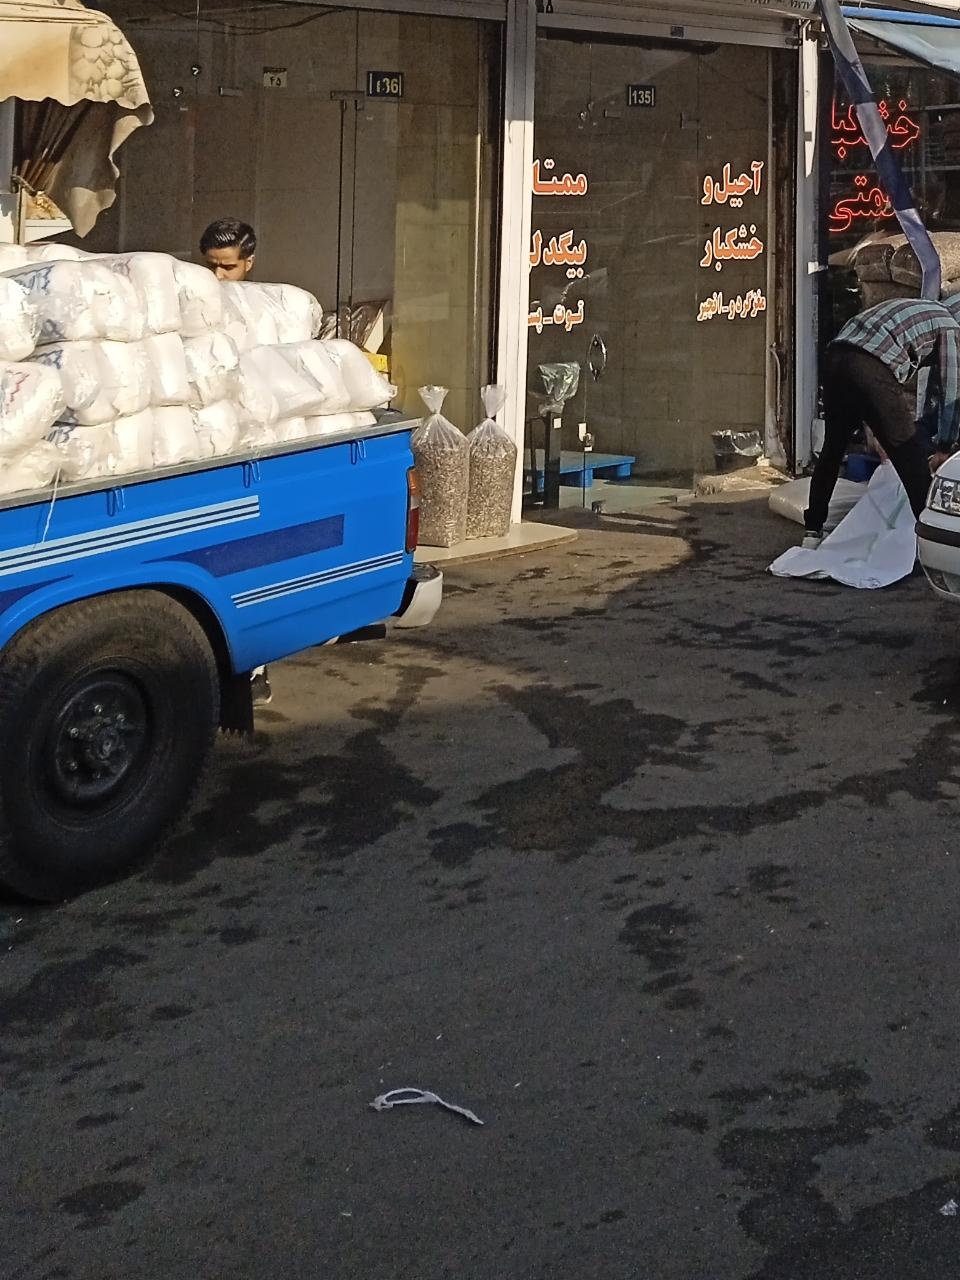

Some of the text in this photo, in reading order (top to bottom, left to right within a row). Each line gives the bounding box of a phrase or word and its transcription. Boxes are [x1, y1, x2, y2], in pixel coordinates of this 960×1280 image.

[632, 90, 651, 104] 135
[532, 158, 588, 196] ممتا
[701, 161, 764, 208] آجیل و
[528, 229, 588, 279] بیگدل
[700, 224, 764, 272] خشکبار
